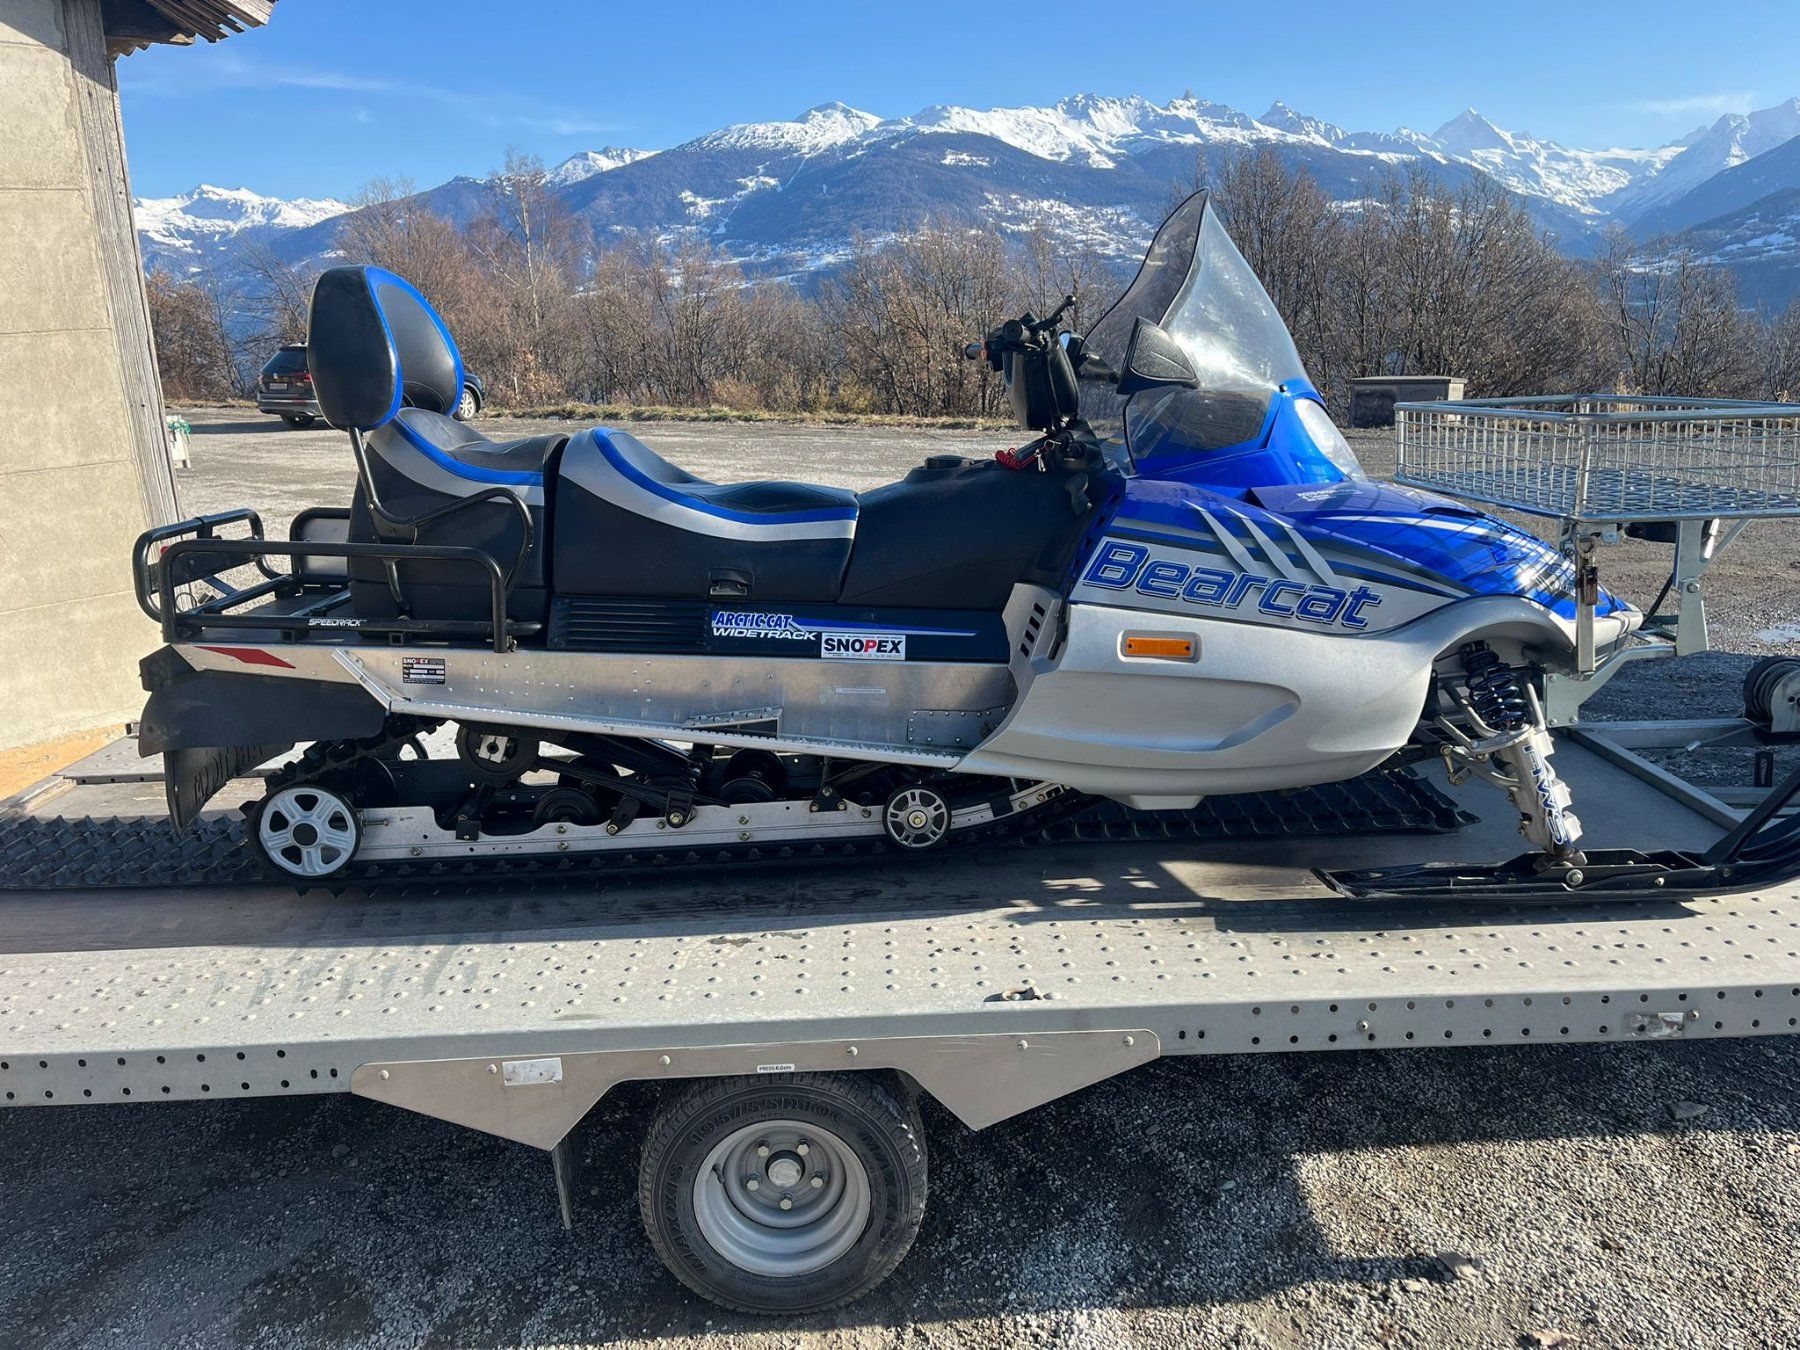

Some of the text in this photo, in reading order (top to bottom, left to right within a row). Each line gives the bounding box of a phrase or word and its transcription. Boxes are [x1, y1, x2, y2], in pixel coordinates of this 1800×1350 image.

[1080, 539, 1384, 628] Bearcat
[308, 618, 361, 627] SPEEDRACK
[715, 611, 793, 629] ARCTIC CAT
[712, 628, 818, 641] WIDETRACK
[824, 637, 903, 653] SNOPEX
[662, 1161, 708, 1273] MAXXIS
